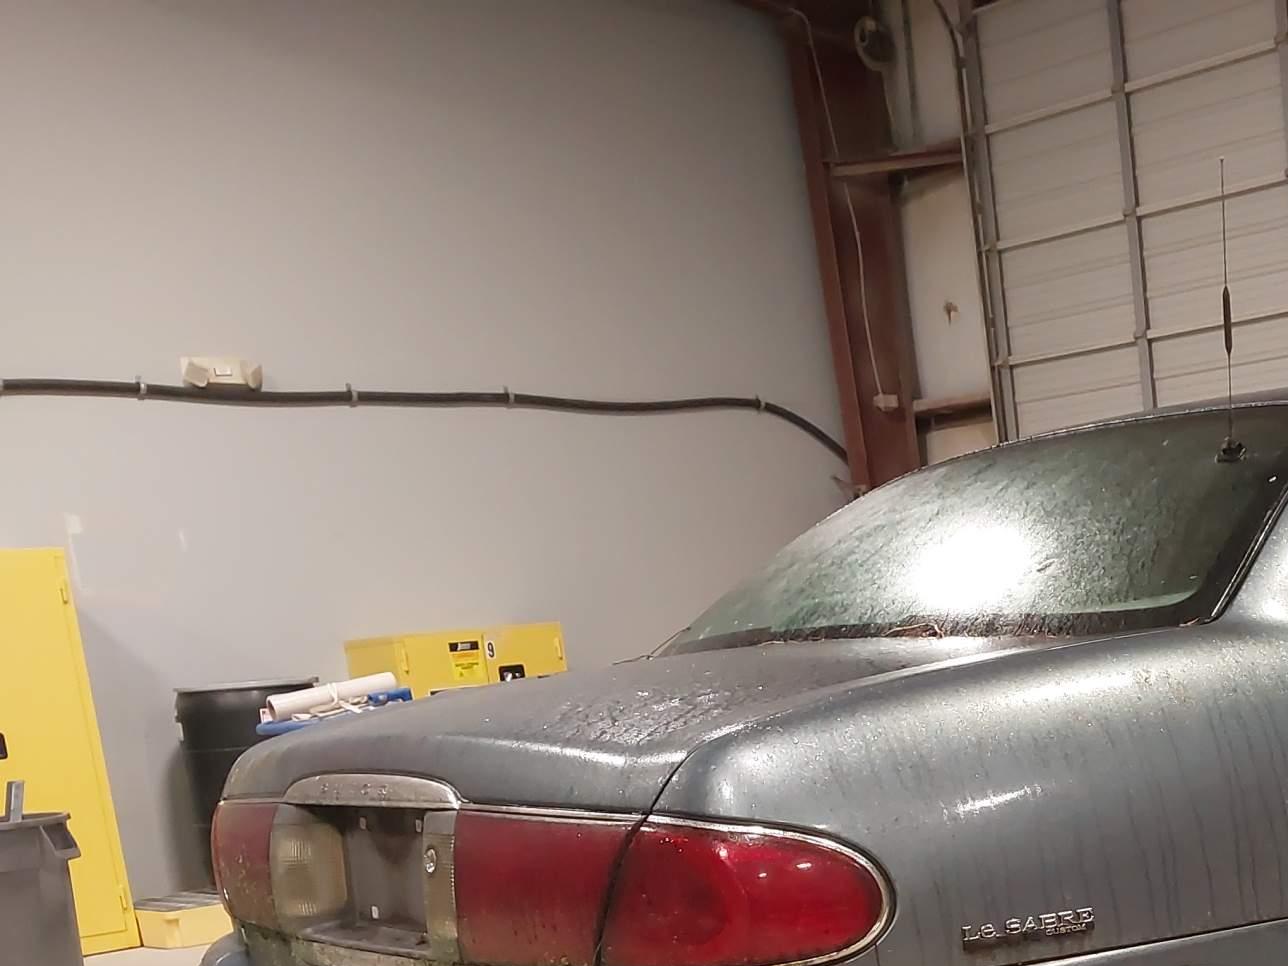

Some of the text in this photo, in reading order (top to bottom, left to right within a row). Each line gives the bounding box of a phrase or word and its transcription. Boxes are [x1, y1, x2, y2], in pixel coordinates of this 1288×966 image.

[487, 641, 495, 658] 9
[1005, 906, 1096, 935] SABRE
[1045, 922, 1088, 936] CUSTOM
